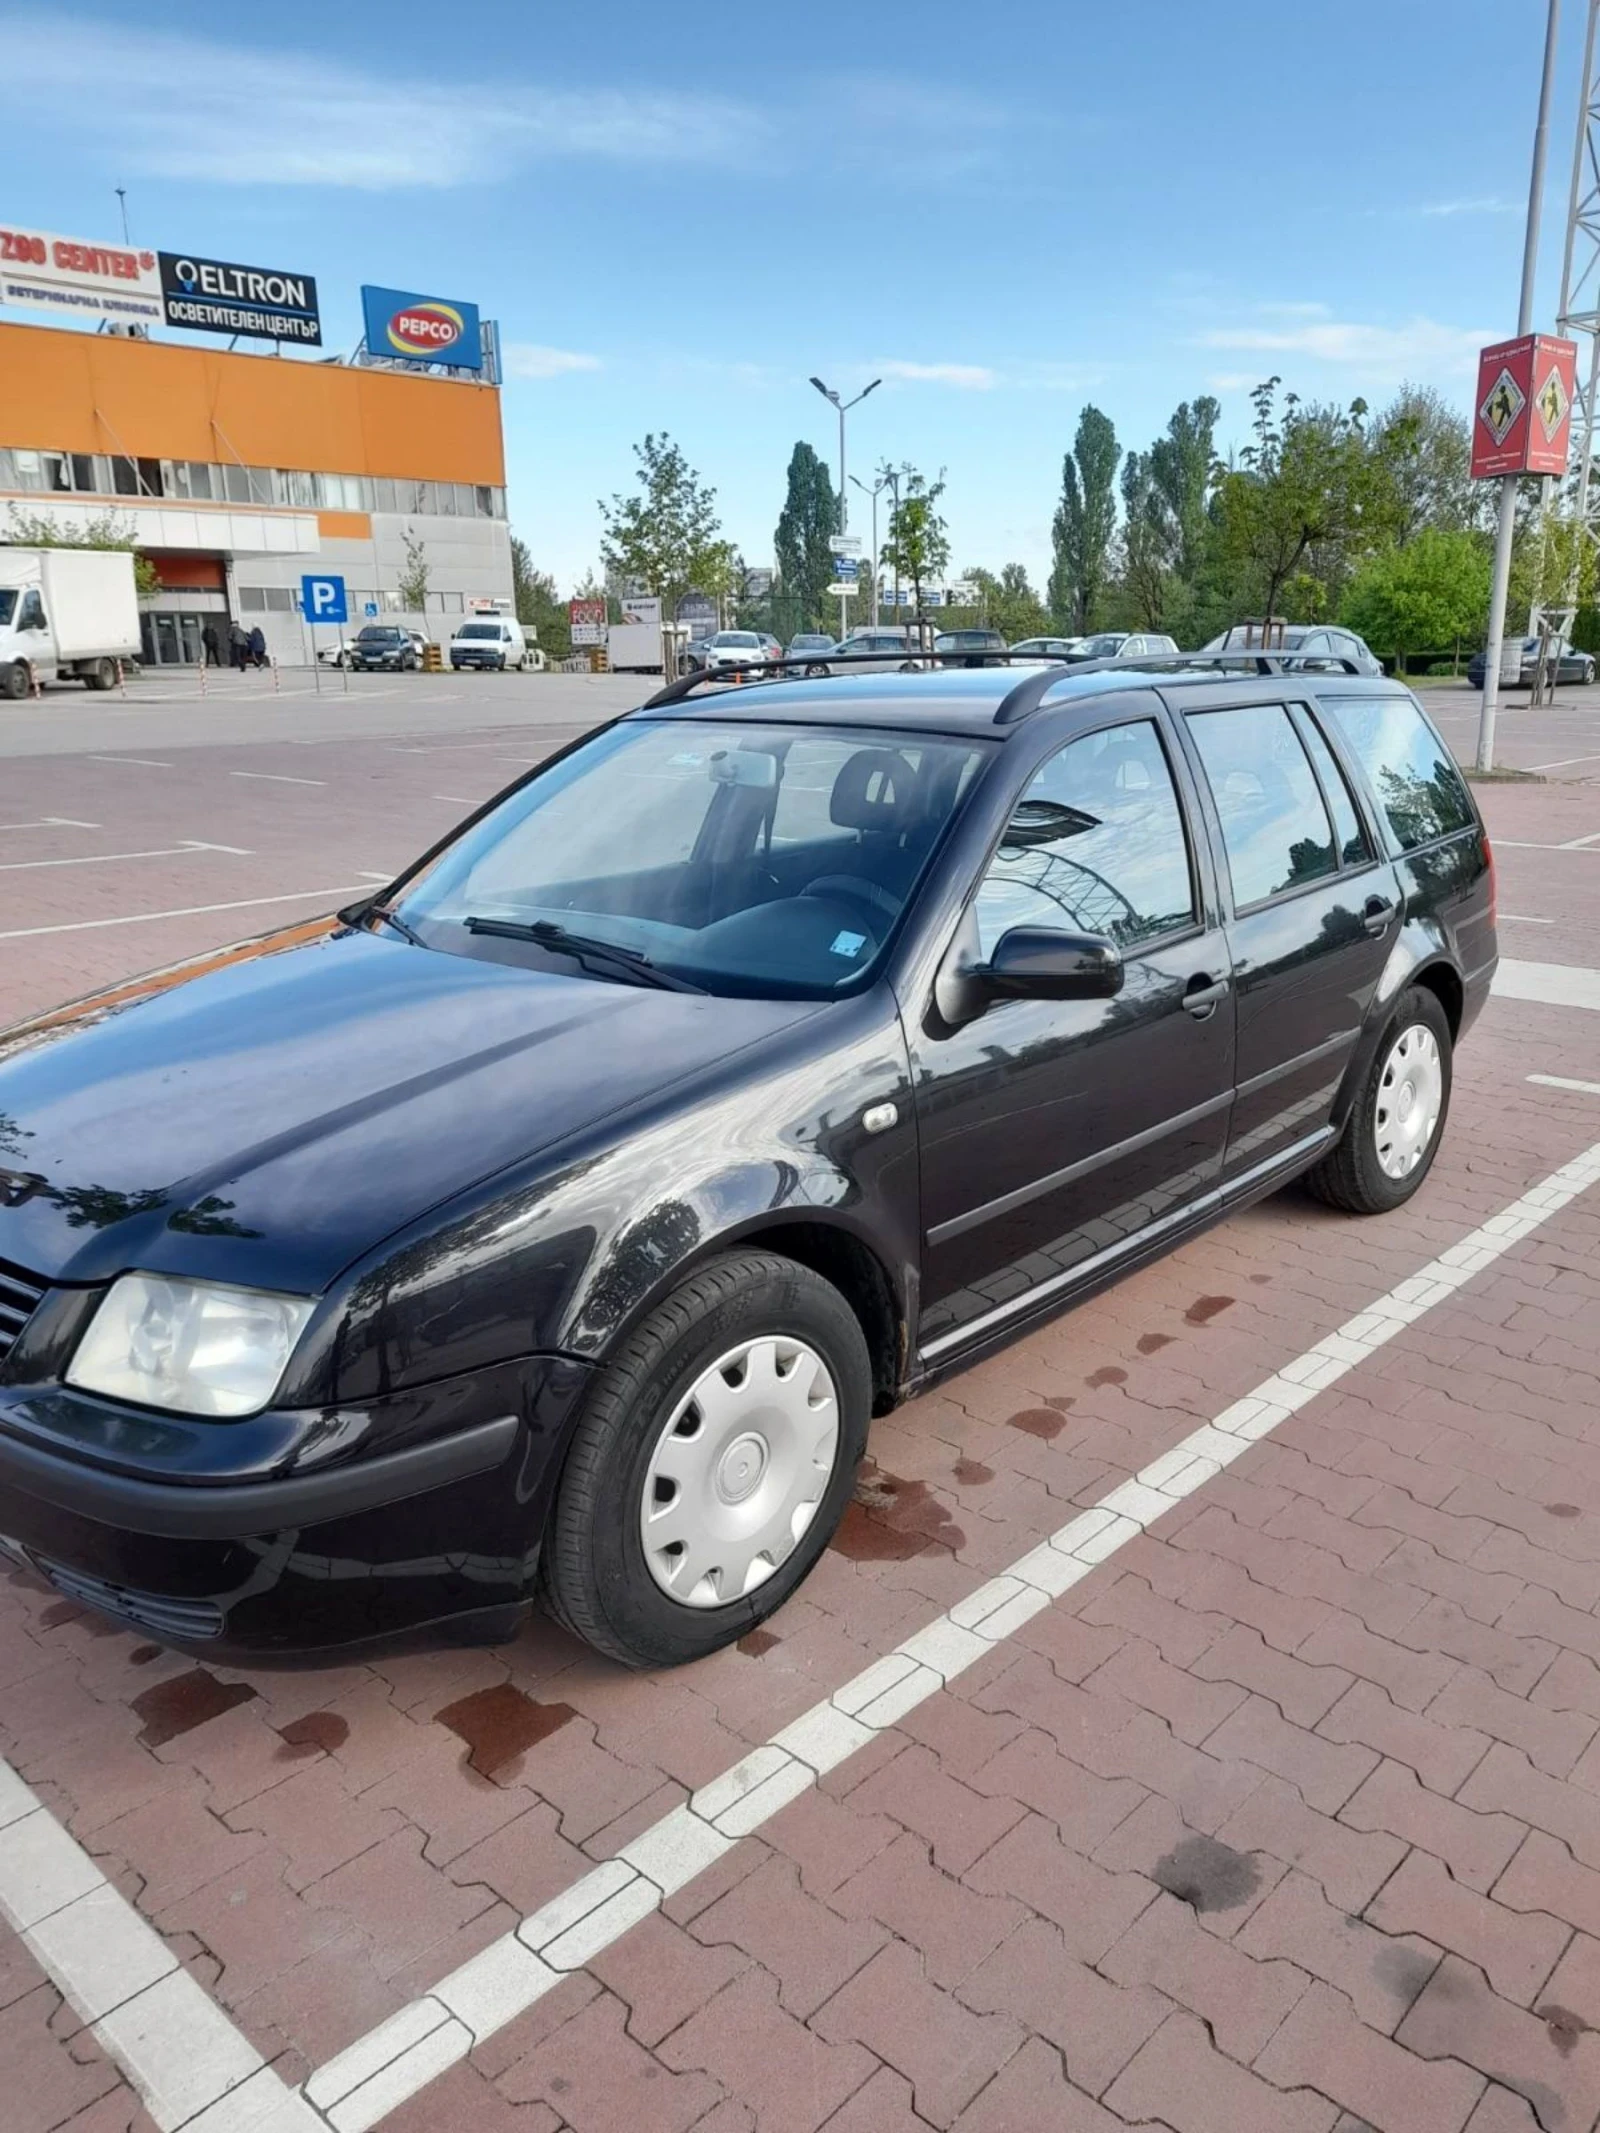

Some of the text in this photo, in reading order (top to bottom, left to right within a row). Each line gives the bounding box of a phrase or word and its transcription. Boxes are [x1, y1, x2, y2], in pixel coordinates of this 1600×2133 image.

[0, 231, 139, 280] ZOO CENTER
[200, 264, 307, 307] ELTRON
[168, 301, 318, 338] ОСВЕТИТЕЛЕН ЦЕНТЪР
[399, 316, 453, 340] PEPCO
[312, 582, 335, 615] P
